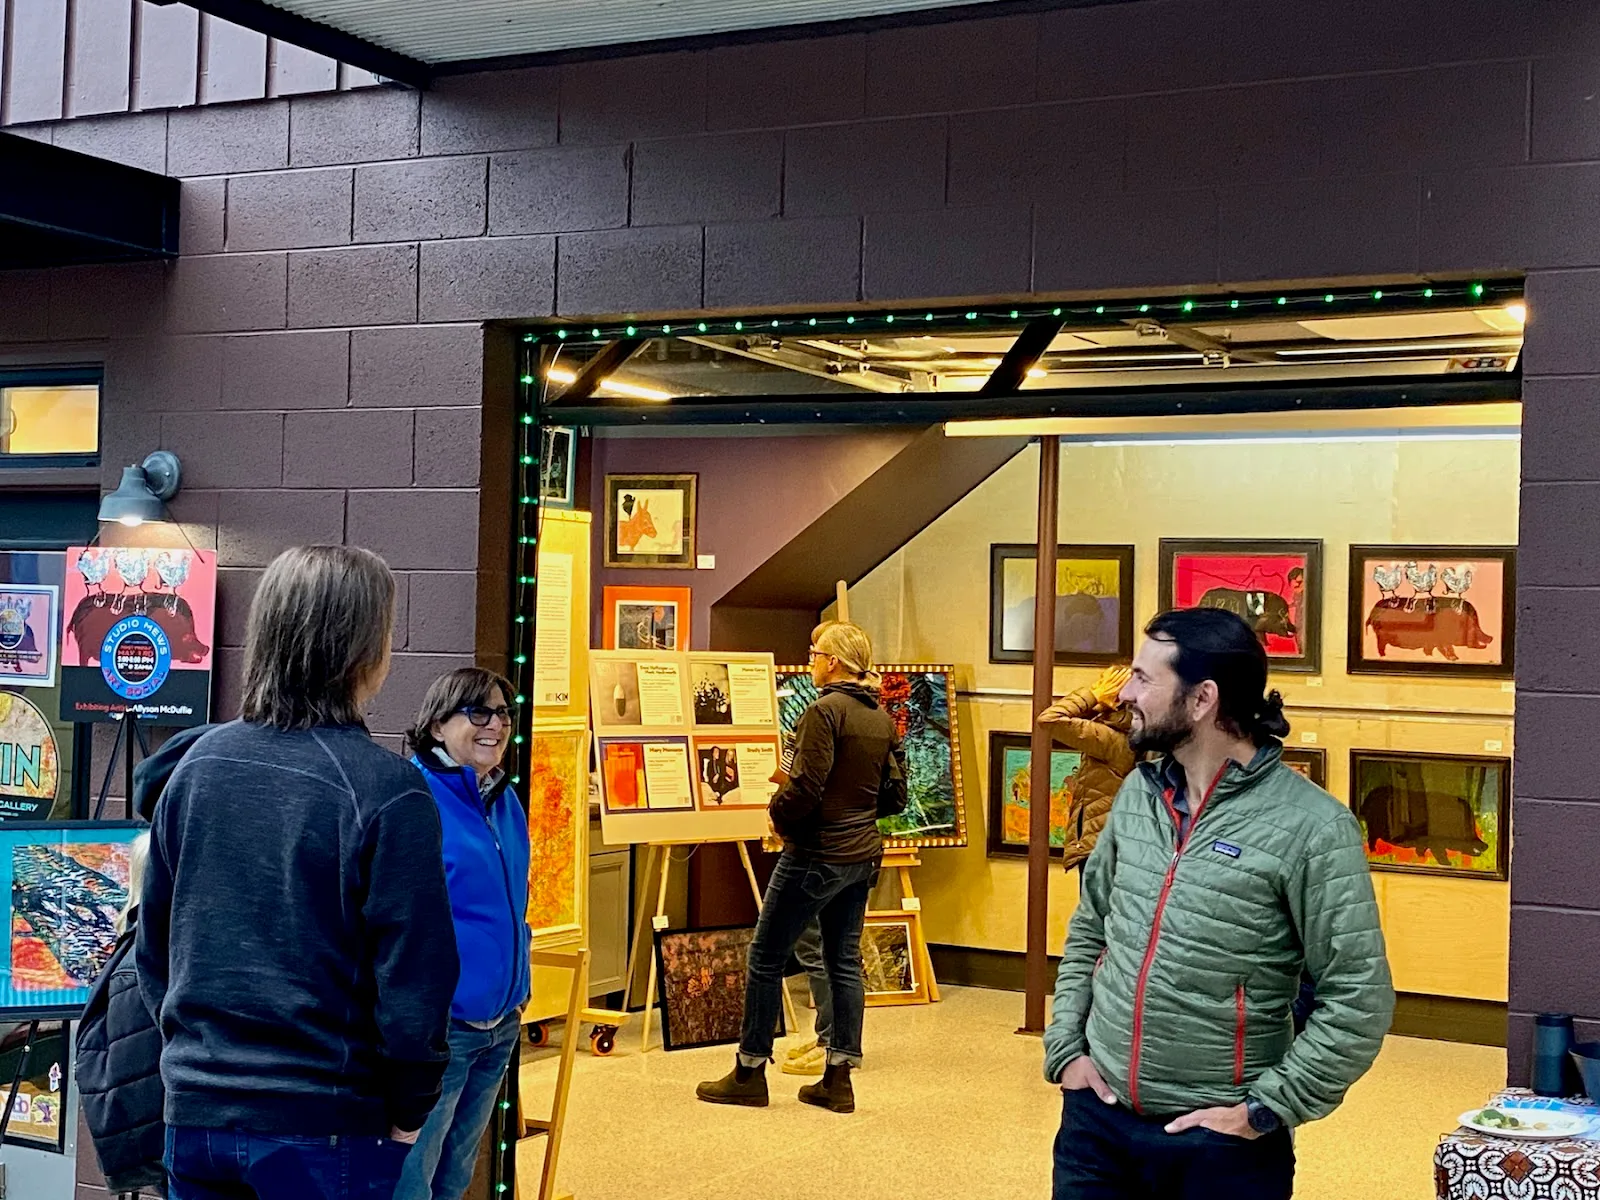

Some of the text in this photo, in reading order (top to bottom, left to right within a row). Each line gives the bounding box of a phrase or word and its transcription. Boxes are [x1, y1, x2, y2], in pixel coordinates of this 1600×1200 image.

[104, 619, 168, 655] STUDIO MEWS
[103, 667, 166, 696] ART SOCIAL
[75, 702, 110, 713] Exhibiting
[133, 704, 158, 714] Allyson
[160, 705, 193, 715] McDuffie
[0, 742, 41, 789] IN
